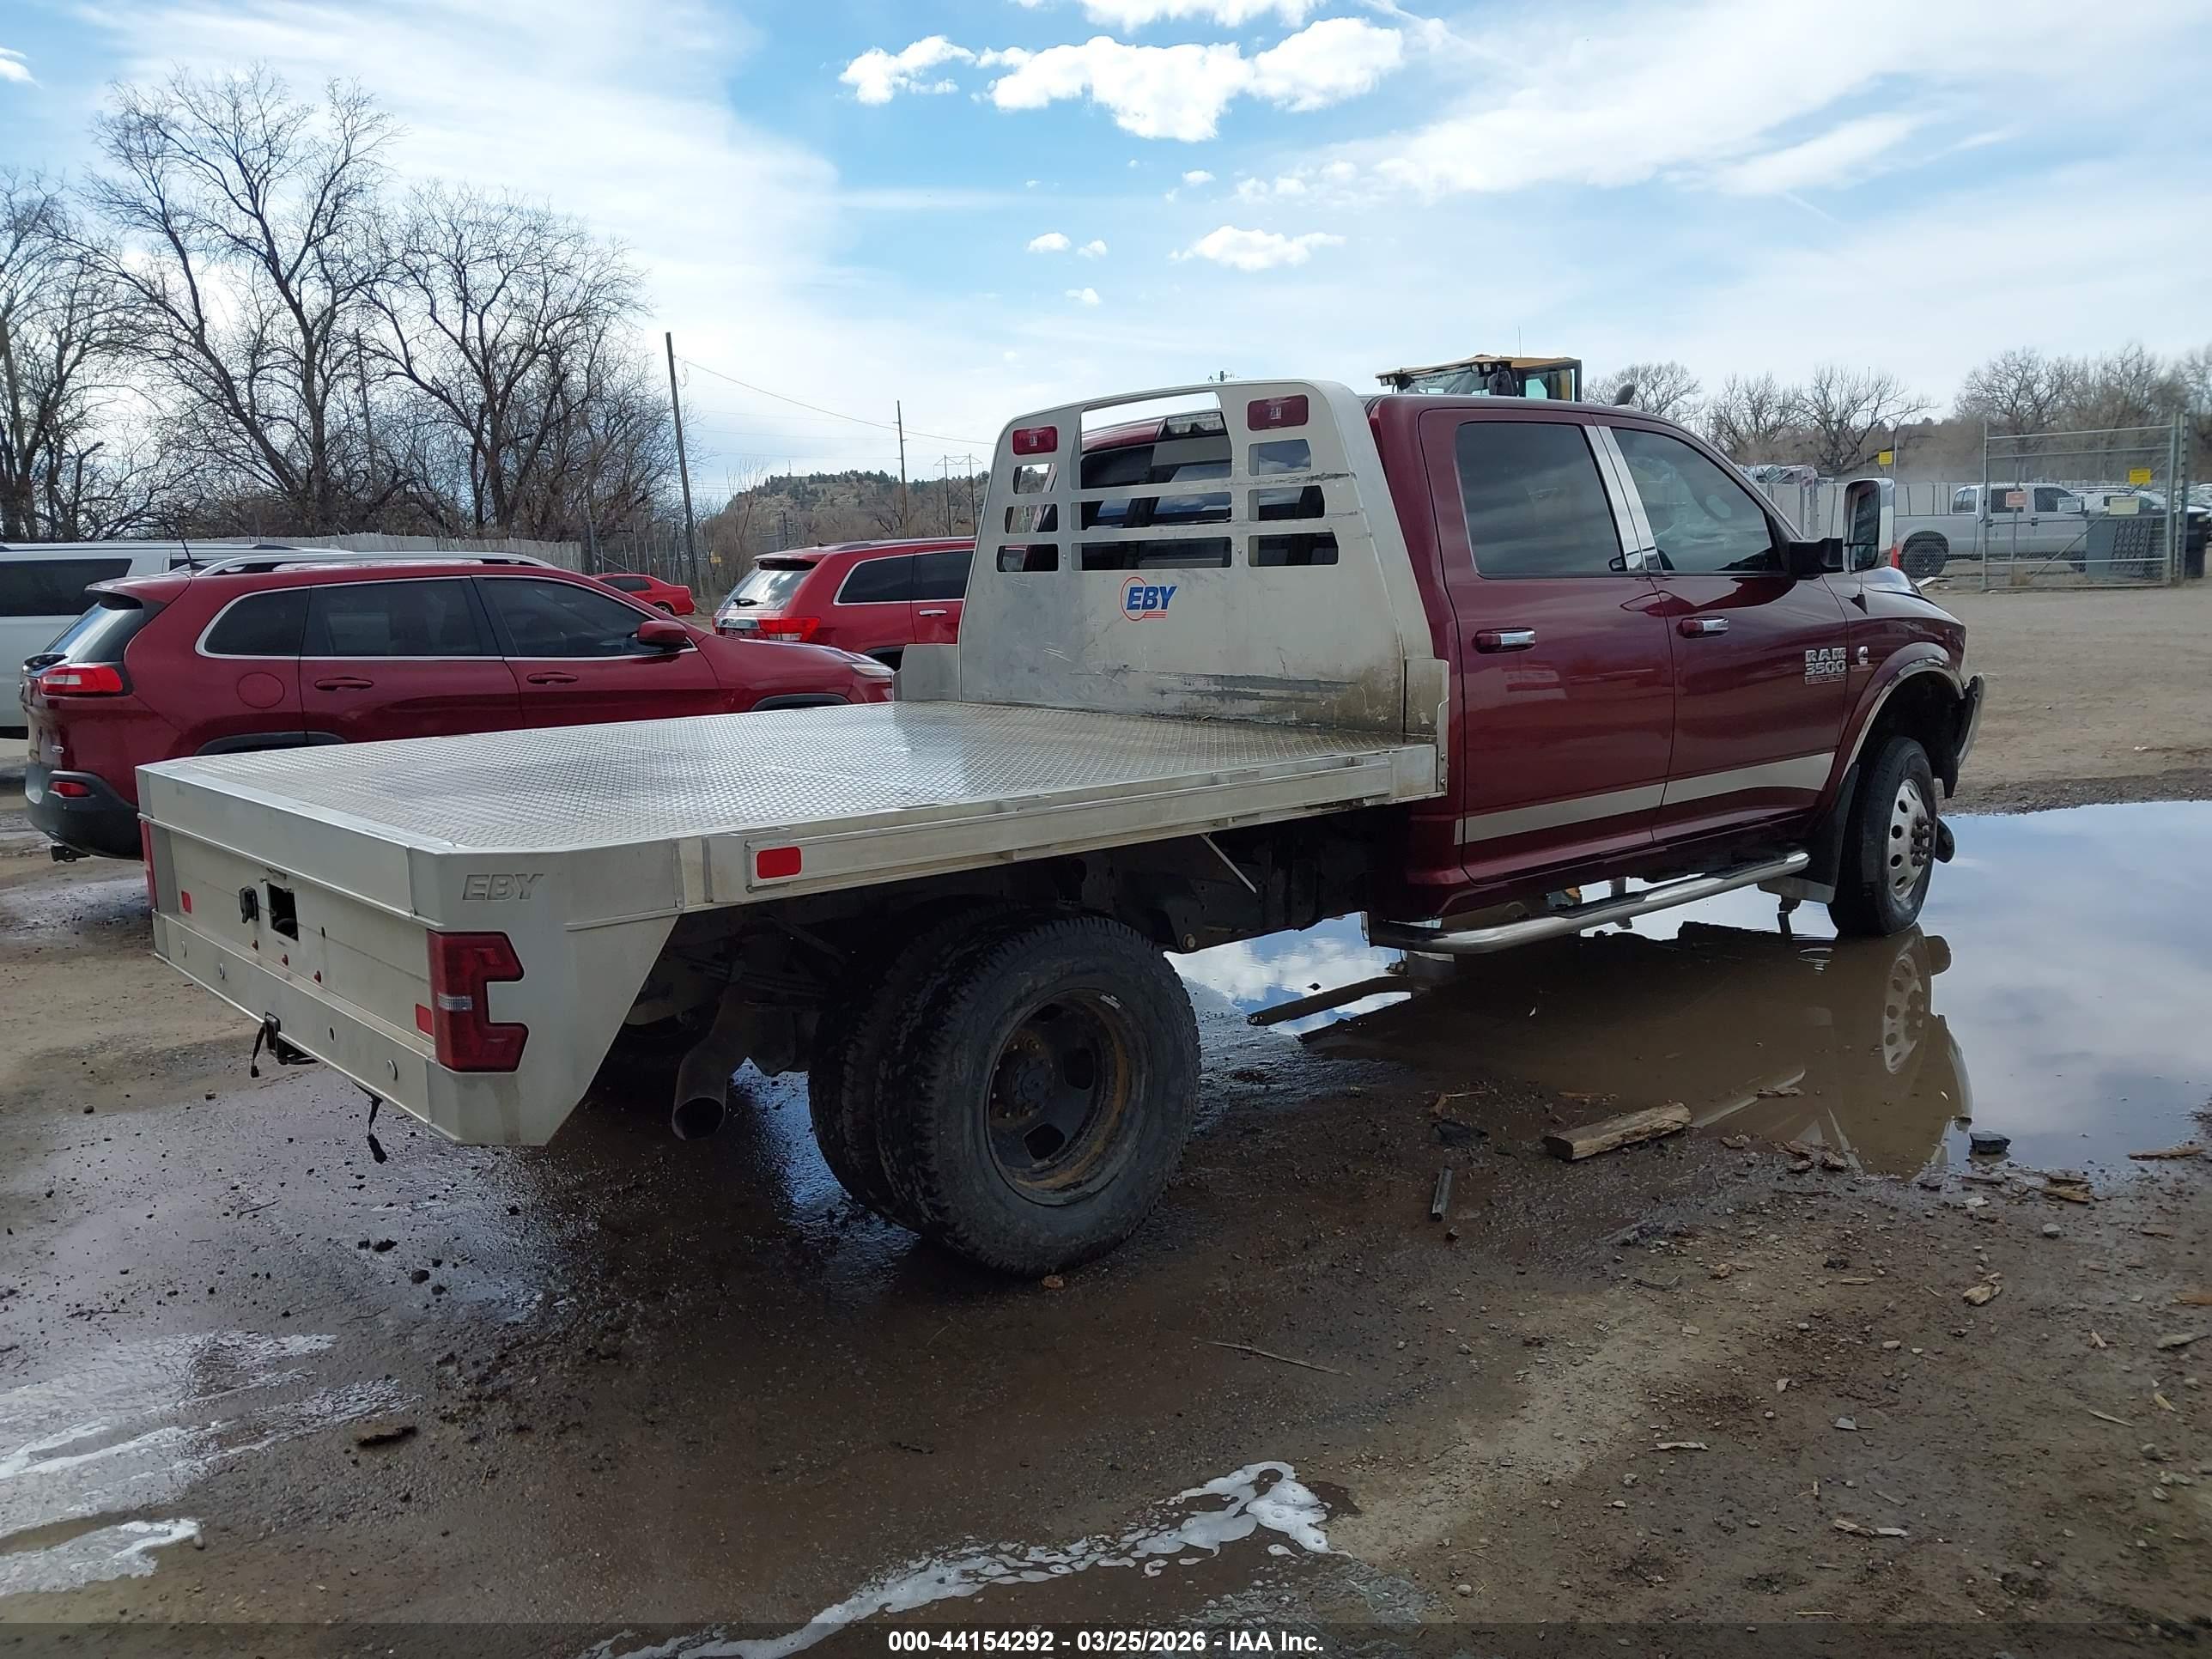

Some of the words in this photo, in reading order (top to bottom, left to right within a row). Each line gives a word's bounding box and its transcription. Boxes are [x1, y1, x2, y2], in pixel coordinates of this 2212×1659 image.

[1126, 586, 1177, 610] EBY
[1805, 647, 1847, 662] RAM
[1805, 660, 1847, 676] 3500
[462, 873, 544, 900] EBY
